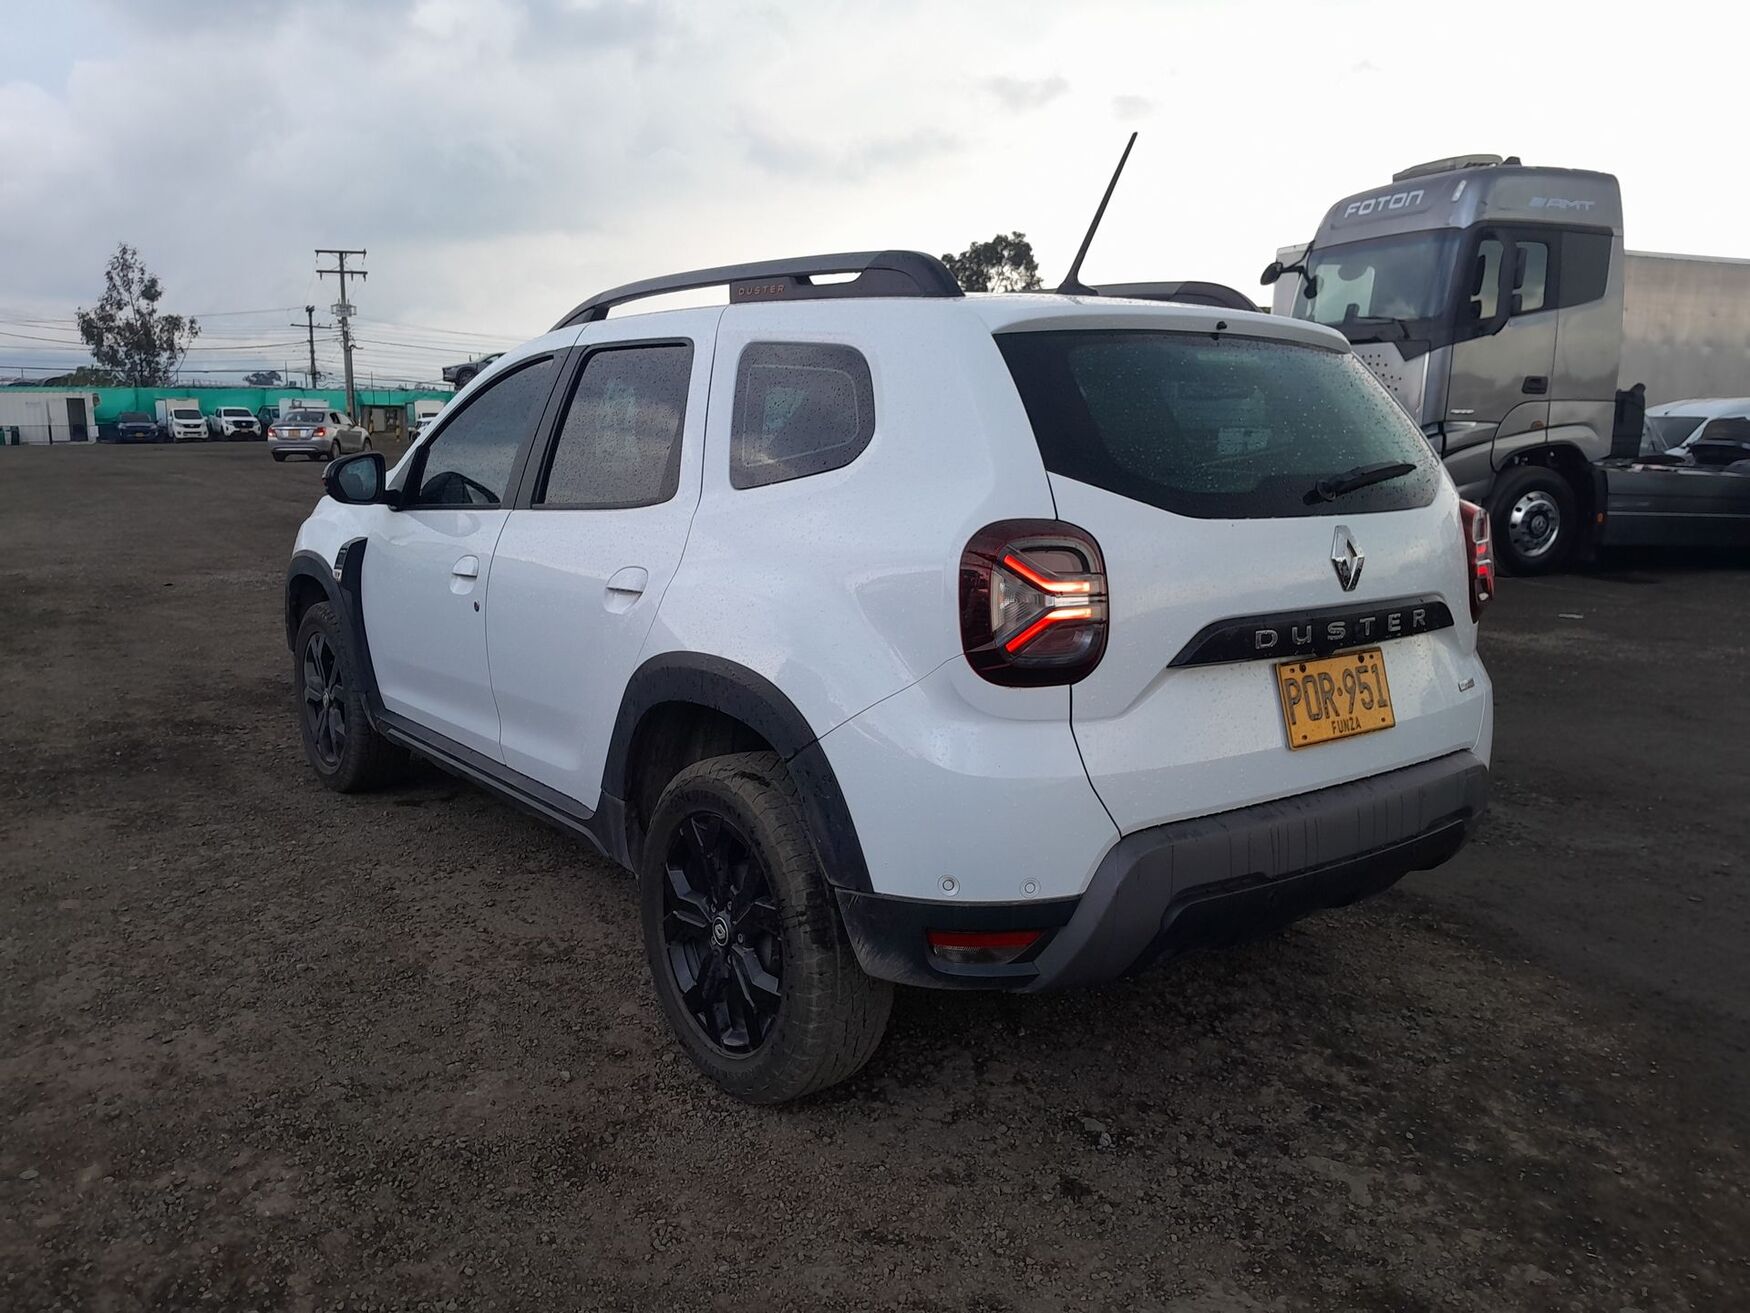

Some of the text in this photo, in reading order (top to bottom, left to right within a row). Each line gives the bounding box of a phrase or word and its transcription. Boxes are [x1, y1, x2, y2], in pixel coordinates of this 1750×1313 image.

[1344, 189, 1425, 218] FOTON
[738, 284, 785, 296] DUSTER
[1255, 607, 1428, 650] DUSTER
[1331, 716, 1362, 735] FUNZA
